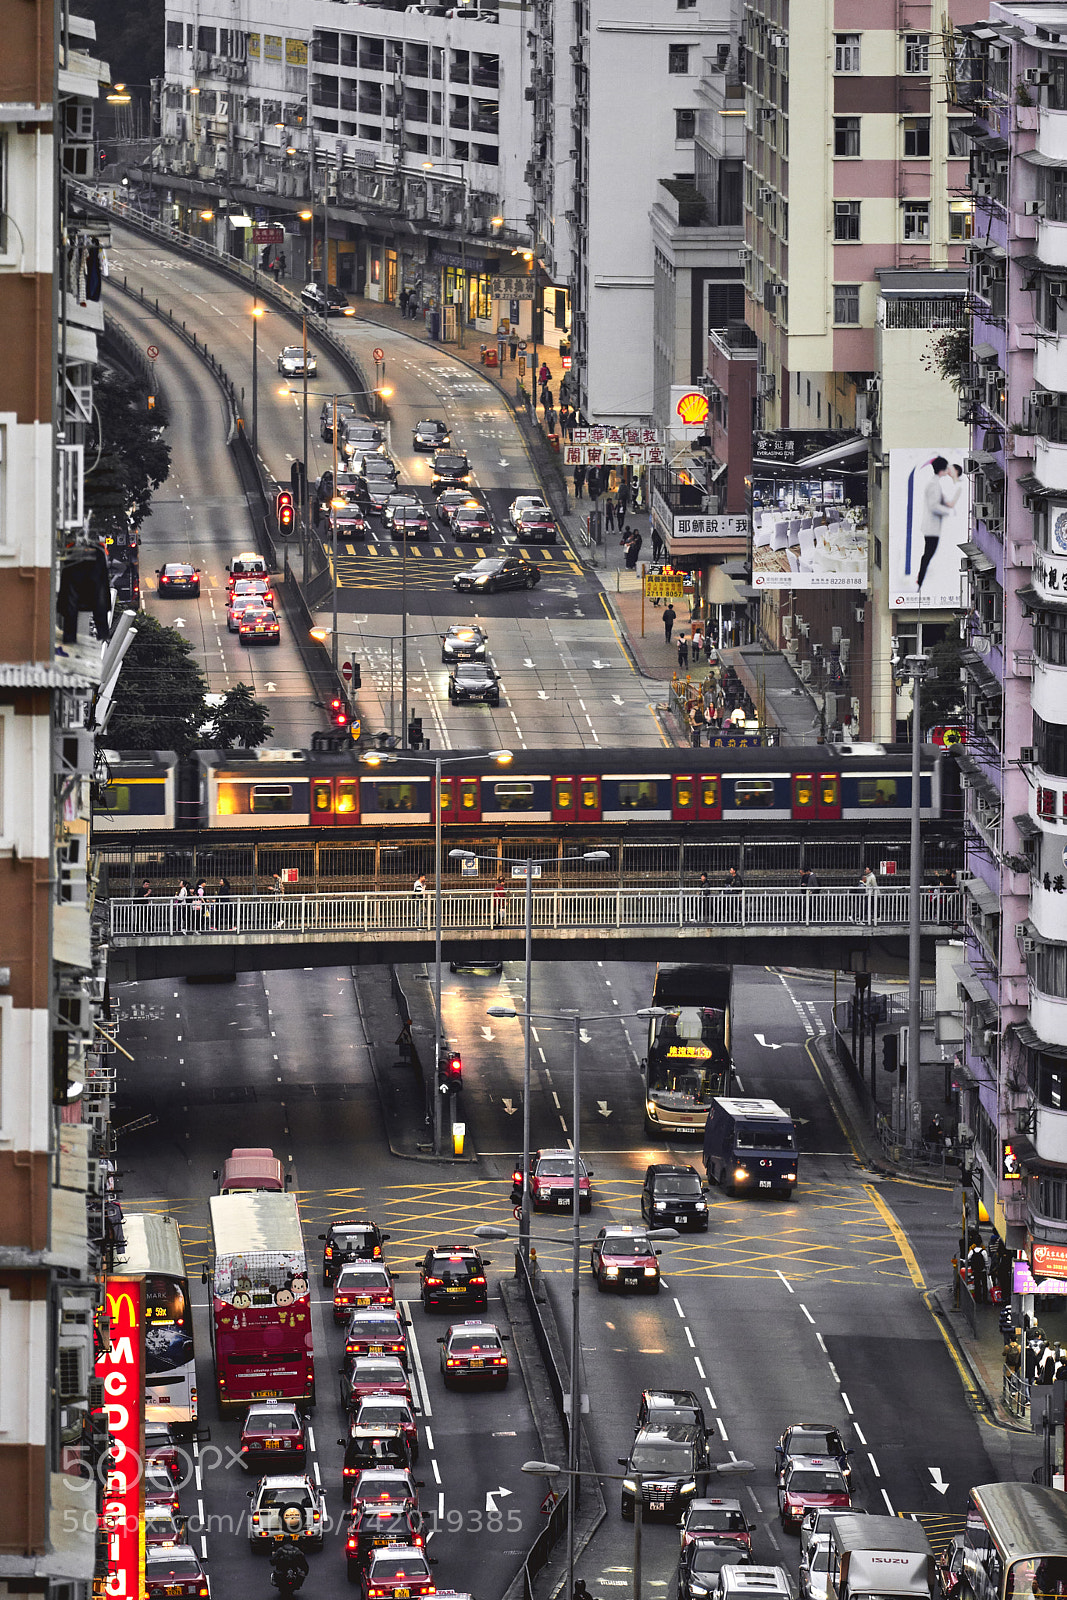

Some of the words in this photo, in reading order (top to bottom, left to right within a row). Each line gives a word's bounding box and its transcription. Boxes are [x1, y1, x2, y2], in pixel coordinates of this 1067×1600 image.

[574, 429, 656, 443] 中華基督教
[566, 447, 662, 464] 閩南三一堂
[871, 1557, 909, 1565] ISUZU
